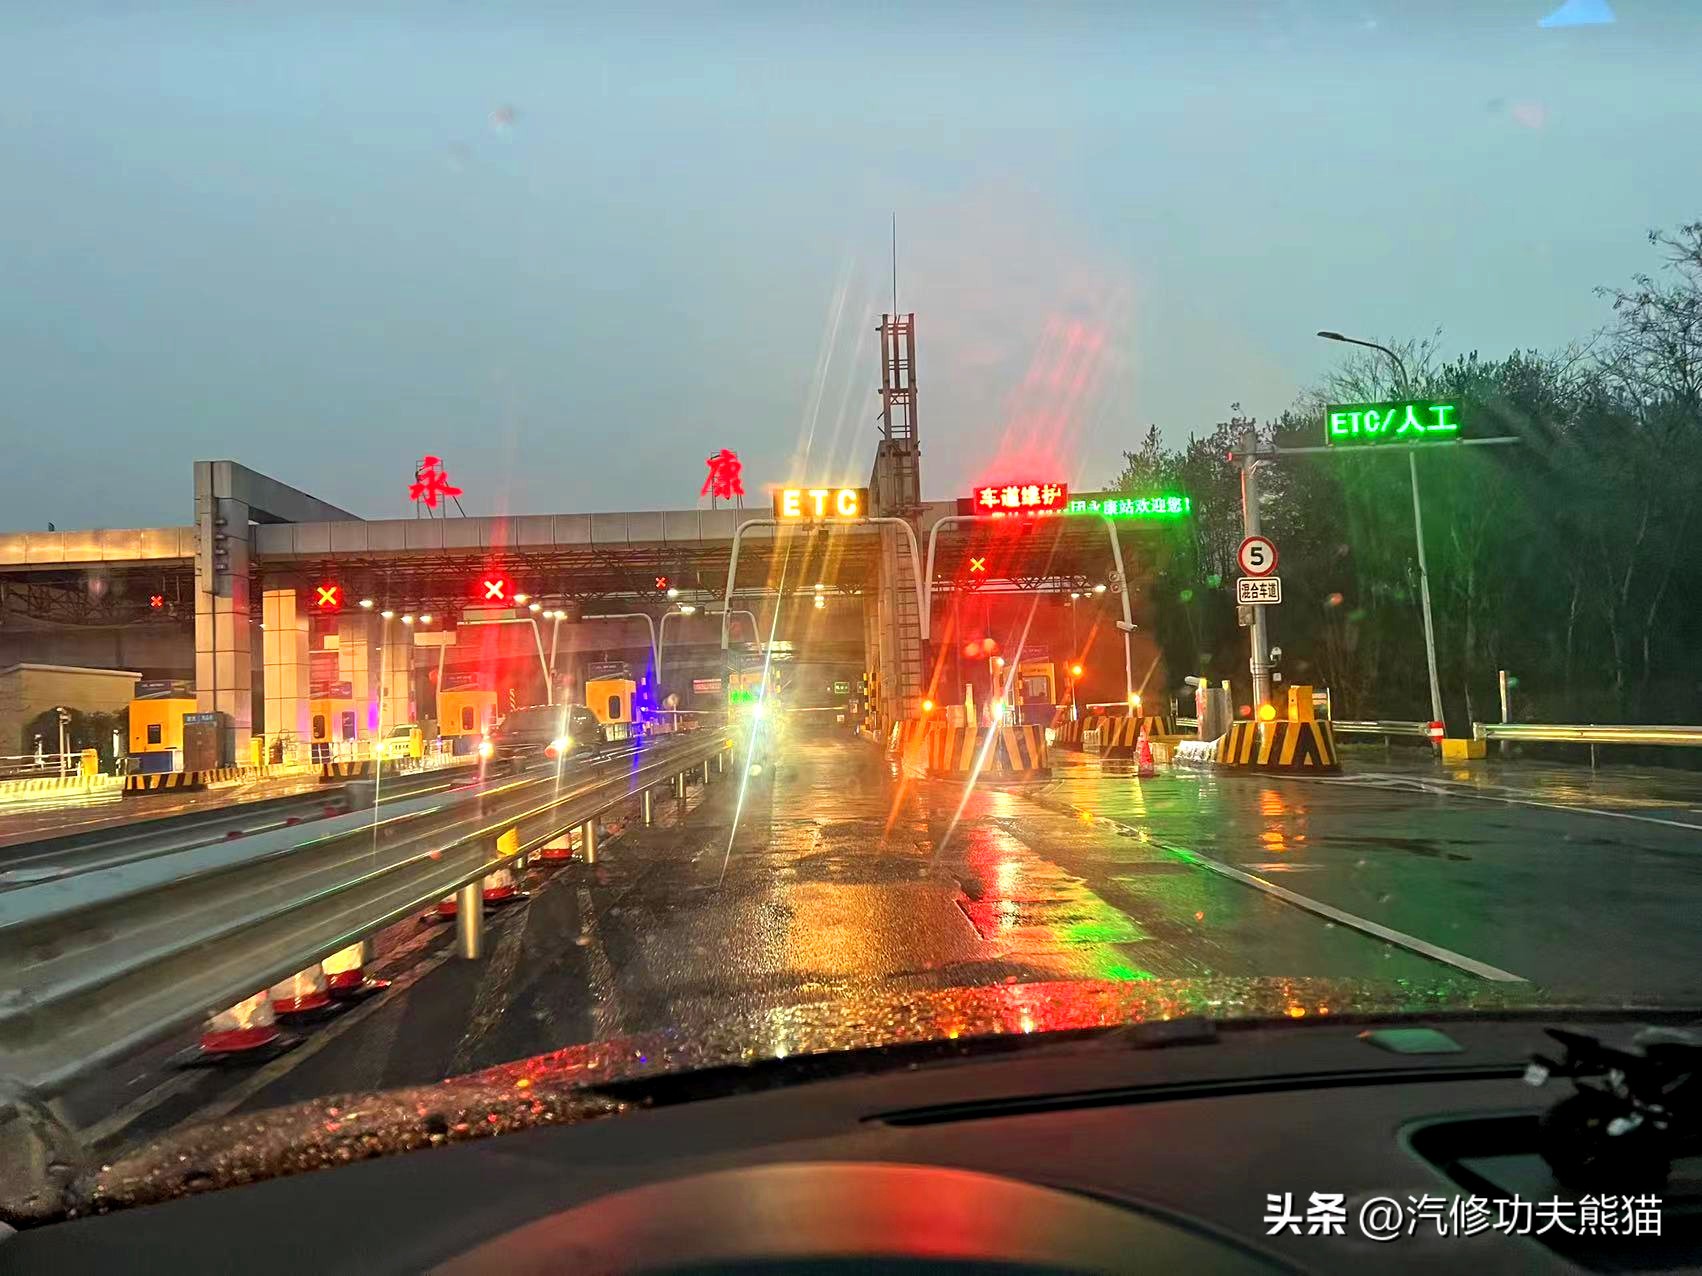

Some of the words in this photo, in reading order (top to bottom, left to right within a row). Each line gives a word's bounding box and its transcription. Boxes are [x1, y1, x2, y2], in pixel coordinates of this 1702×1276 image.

[1331, 404, 1458, 434] ETC/人工
[408, 455, 464, 508] 永
[782, 490, 858, 517] ETC
[979, 483, 1062, 508] 车道维护
[1250, 546, 1264, 566] 5
[1240, 583, 1278, 600] 混合车道
